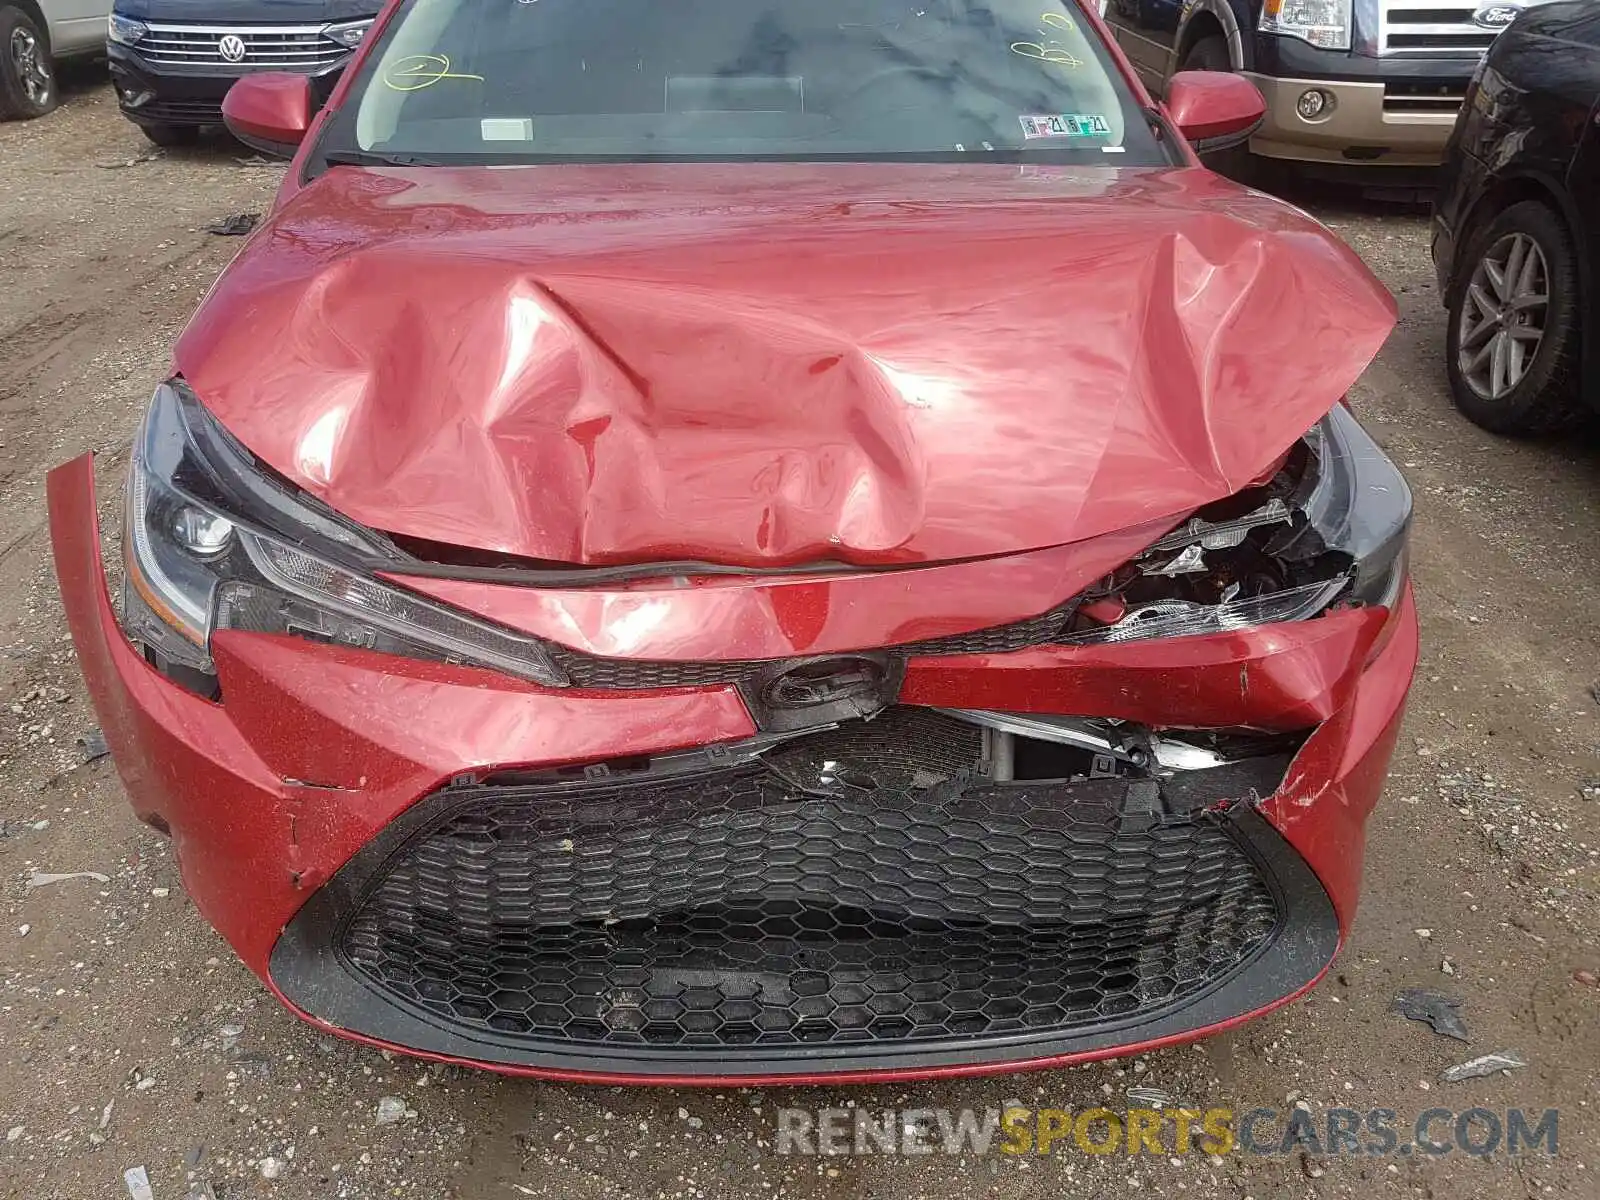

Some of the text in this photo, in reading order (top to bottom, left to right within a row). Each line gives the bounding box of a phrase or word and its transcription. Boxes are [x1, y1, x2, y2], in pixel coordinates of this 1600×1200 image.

[1486, 7, 1517, 22] Ford
[1047, 117, 1065, 133] 21
[1089, 116, 1108, 132] 21
